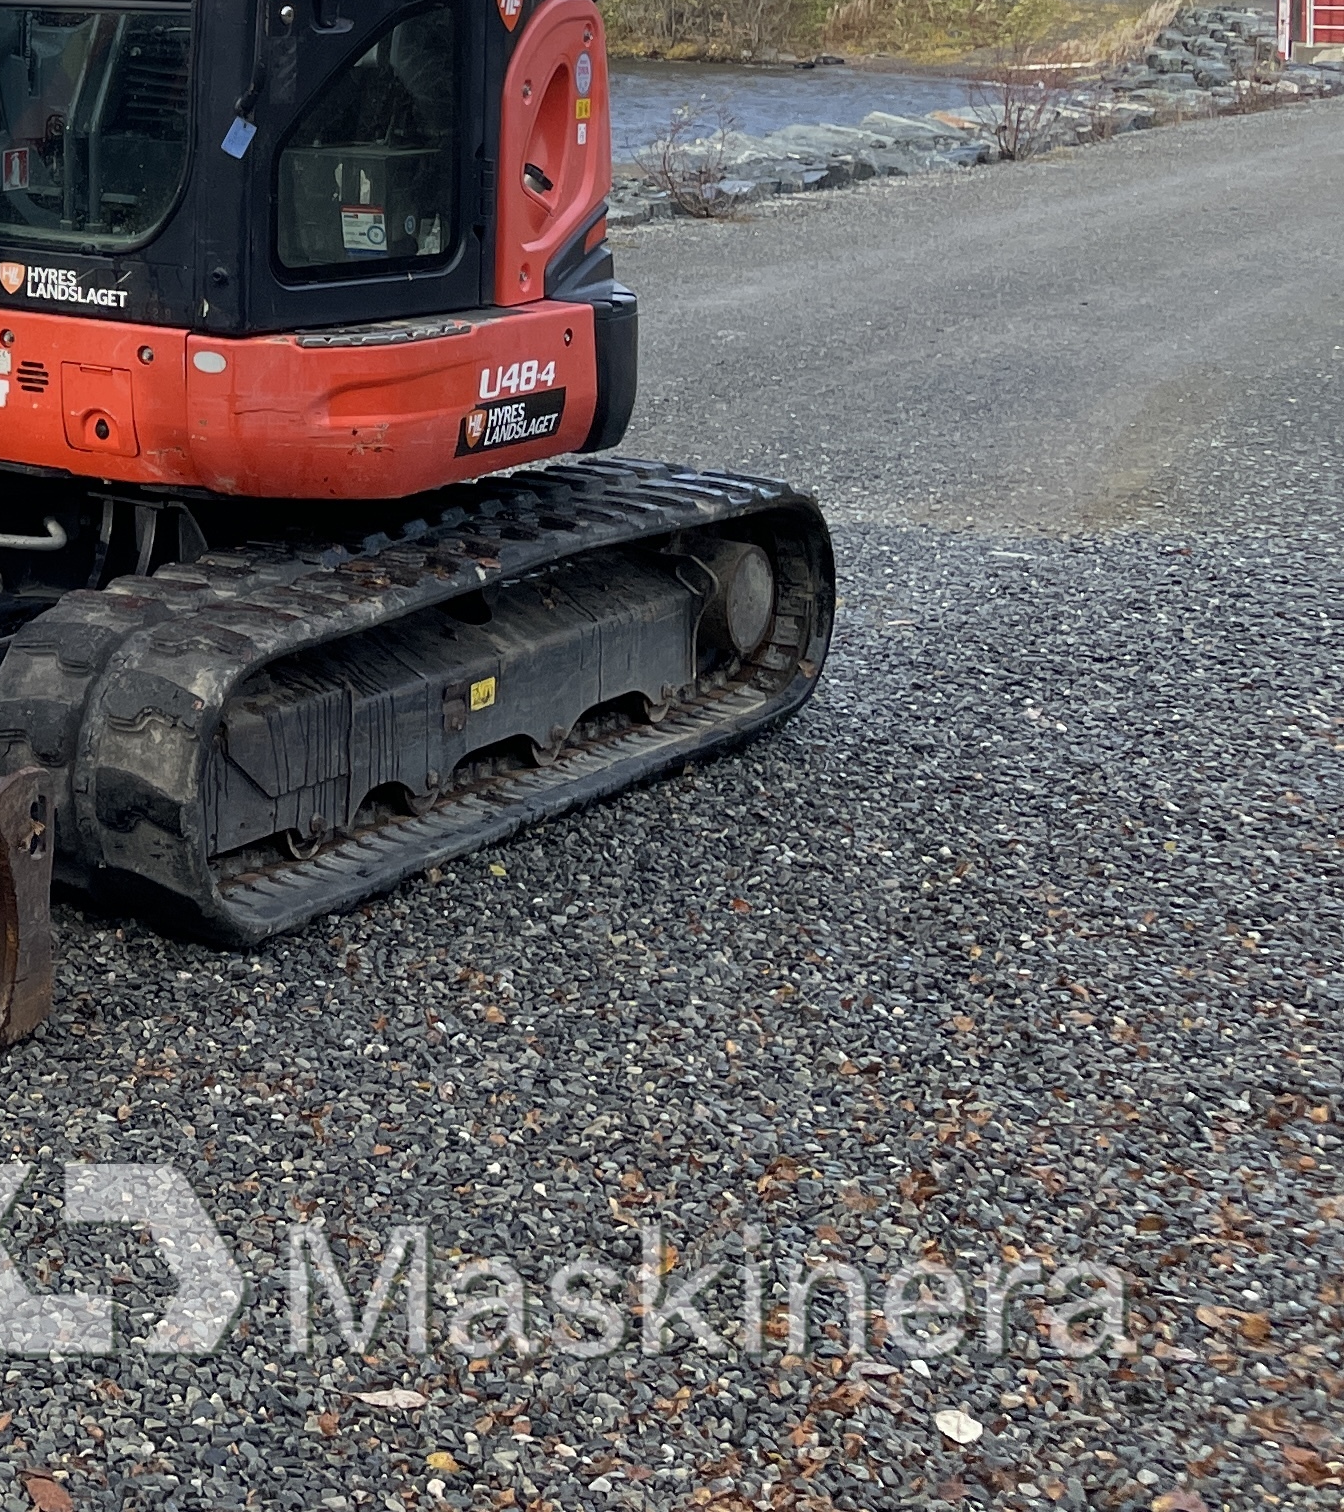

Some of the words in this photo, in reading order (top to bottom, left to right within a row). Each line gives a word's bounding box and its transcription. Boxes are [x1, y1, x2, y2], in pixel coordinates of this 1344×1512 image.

[27, 266, 77, 287] HYRES
[26, 281, 128, 307] LANDSLAGET
[487, 402, 526, 428] HYRES
[483, 413, 559, 446] LANDSLAGET
